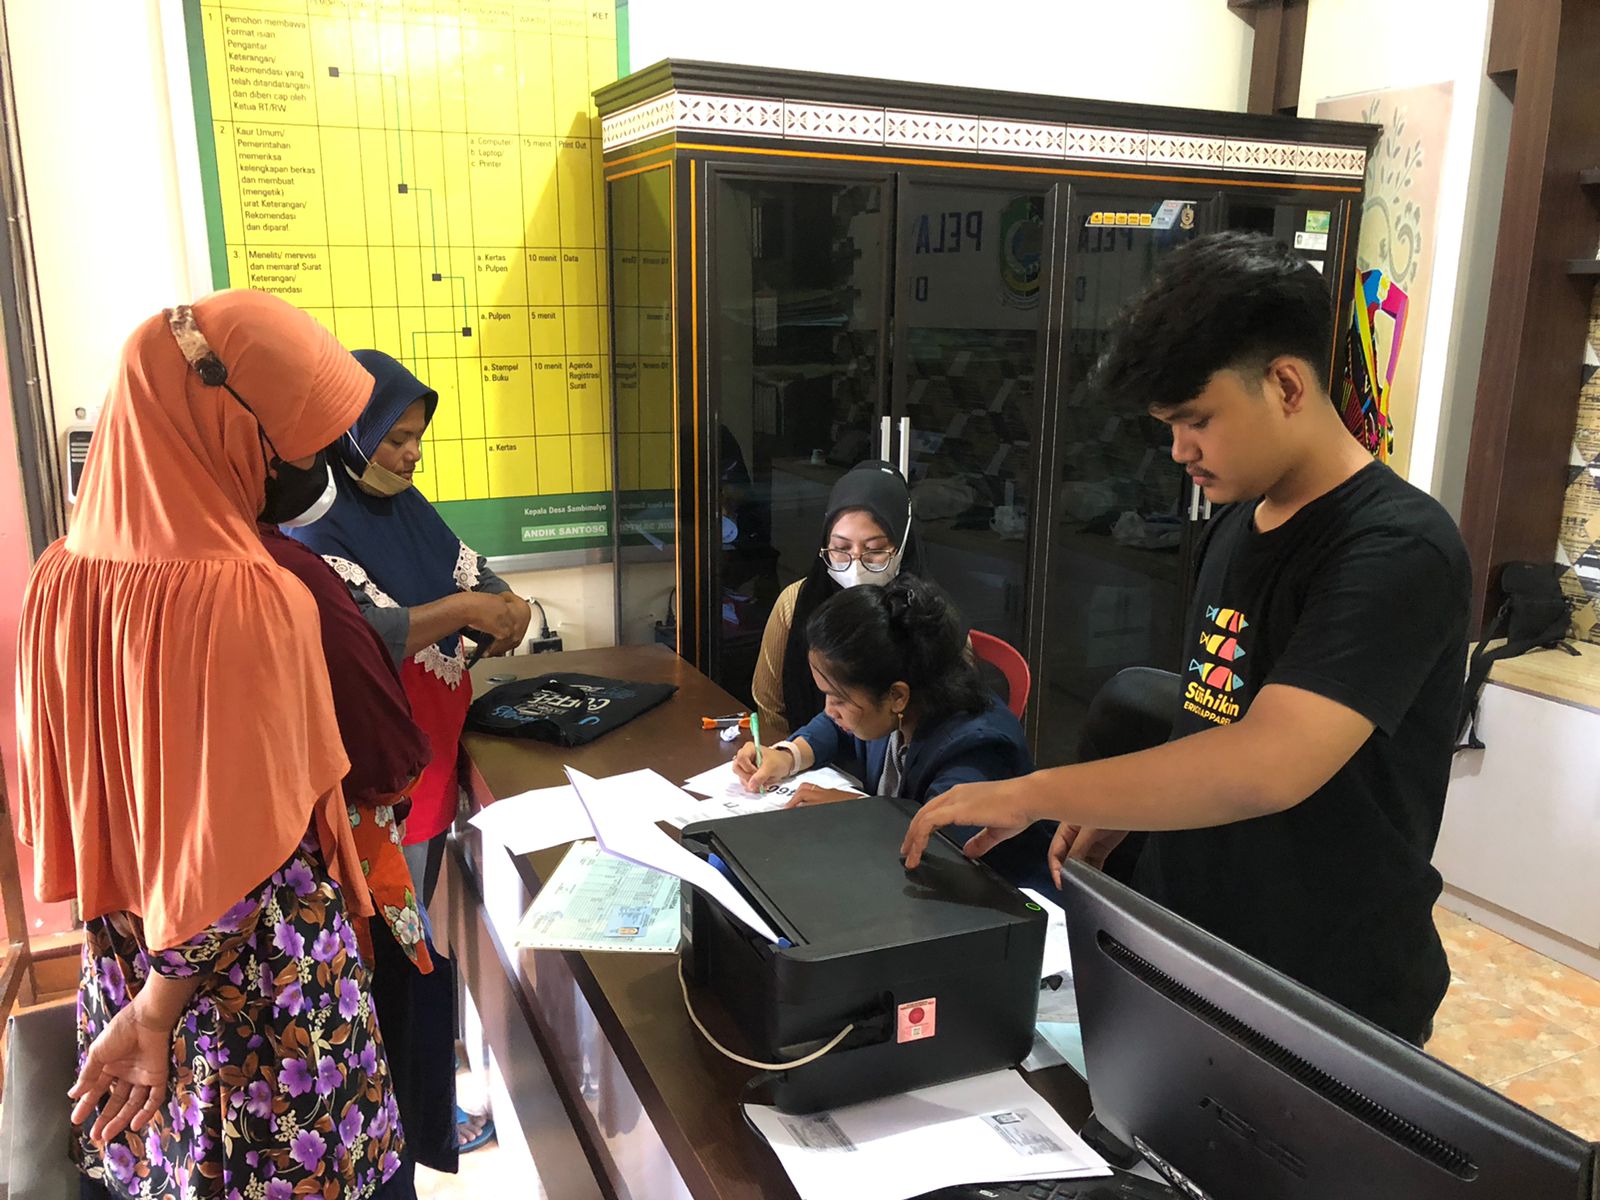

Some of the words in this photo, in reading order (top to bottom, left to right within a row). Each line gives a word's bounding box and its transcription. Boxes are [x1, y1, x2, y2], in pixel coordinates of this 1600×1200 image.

[592, 12, 608, 20] KET
[225, 14, 262, 25] Pemohon
[264, 18, 306, 28] membawa
[226, 27, 255, 37] Format
[227, 40, 267, 51] Pengantar
[230, 64, 283, 76] Rekomendasi
[285, 71, 304, 79] yang
[231, 78, 251, 86] telah
[253, 79, 310, 91] ditandatangani
[233, 90, 247, 98] dan
[234, 101, 256, 111] Ketua
[258, 103, 287, 112] RT/RW
[236, 128, 253, 136] Kaur
[237, 139, 291, 149] Pemerintahan
[478, 137, 511, 146] Computer
[239, 152, 282, 161] memeriksa
[479, 160, 501, 168] Printer
[240, 164, 289, 174] kelengkapan
[290, 166, 315, 174] berkas
[241, 176, 256, 184] dan
[258, 177, 294, 185] membuat
[242, 188, 284, 197] (mengetik)
[245, 211, 296, 220] Rekomendasi
[246, 223, 260, 231] dan
[485, 254, 506, 262] Kertas
[528, 254, 537, 262] 10
[563, 254, 579, 262] Data
[250, 262, 264, 270] dan
[266, 262, 300, 271] memaraf
[302, 262, 322, 271] Surat
[485, 265, 508, 273] Pulpen
[488, 312, 511, 321] Pulpen
[531, 312, 536, 320] 5
[537, 312, 556, 320] menit
[491, 363, 519, 371] Stempel
[534, 362, 543, 370] 10
[544, 362, 562, 370] menit
[568, 362, 593, 371] Agenda
[492, 374, 509, 382] Buku
[569, 371, 600, 380] Registrasi
[569, 382, 587, 390] Surat
[496, 443, 517, 451] Kertas
[524, 508, 547, 516] Kepala
[548, 506, 566, 514] Desa
[567, 503, 607, 513] Sambimulyo
[524, 529, 556, 539] ANDIK
[558, 525, 606, 536] SANTOSO
